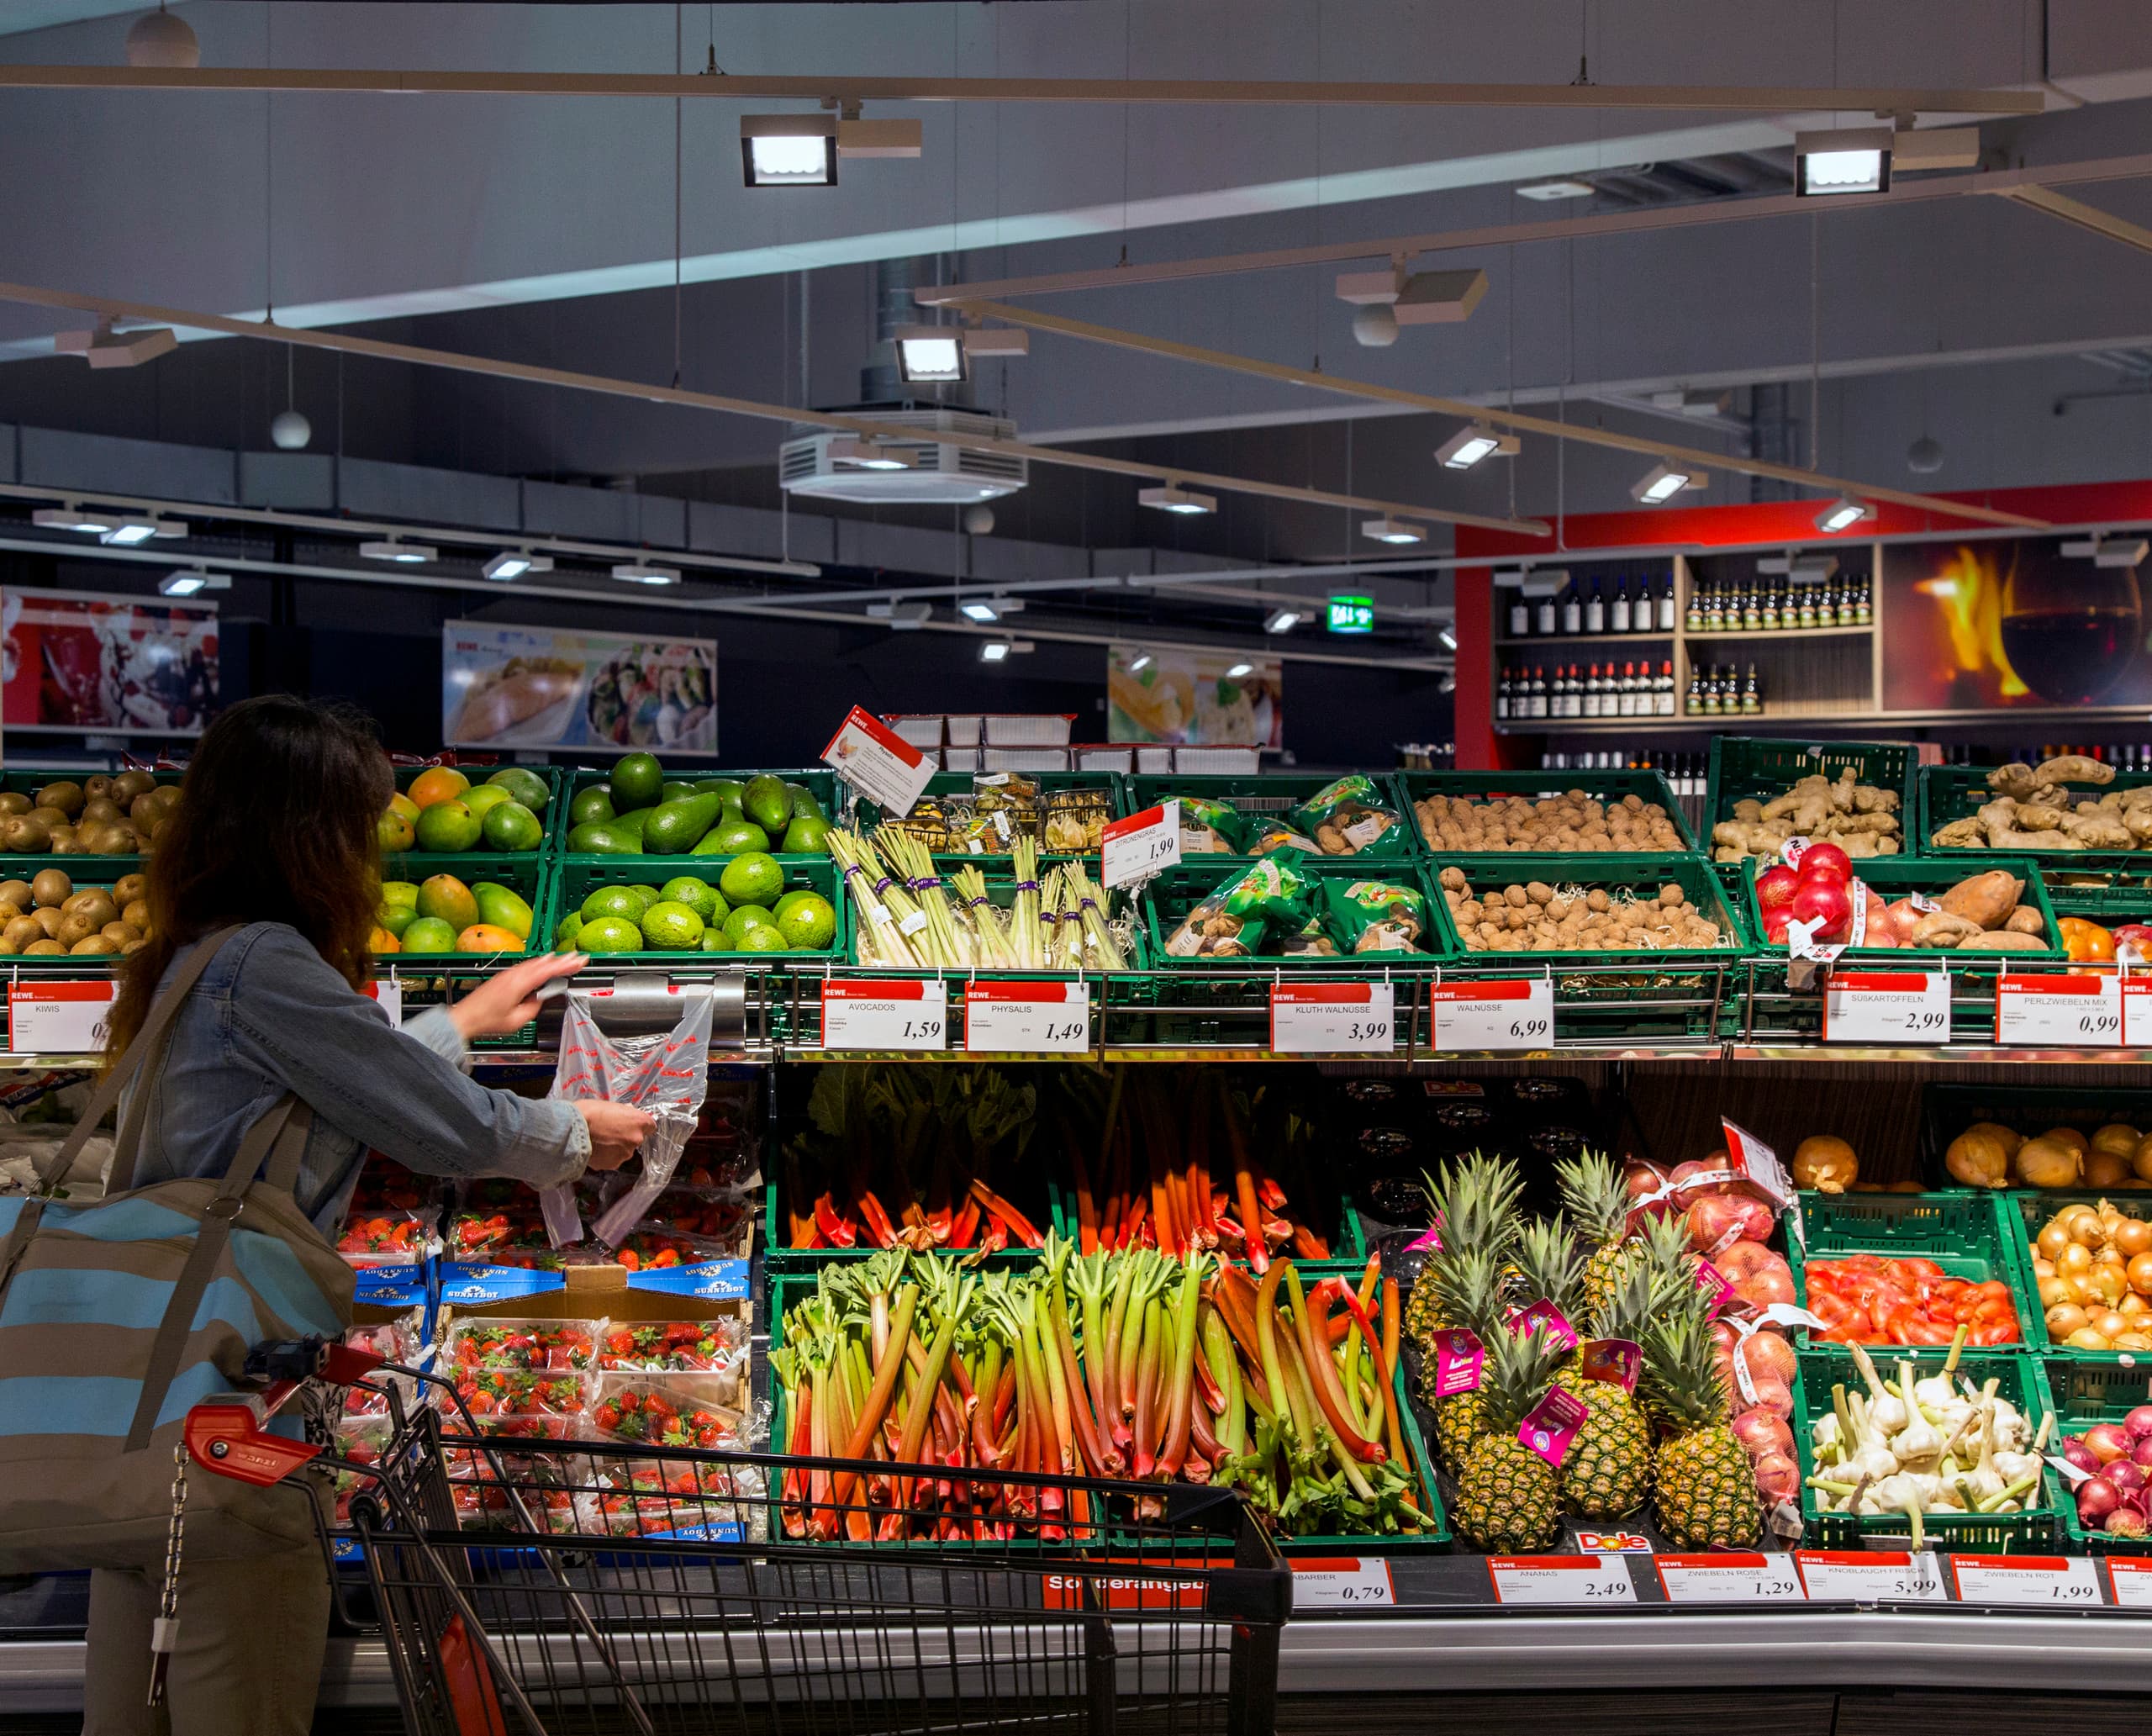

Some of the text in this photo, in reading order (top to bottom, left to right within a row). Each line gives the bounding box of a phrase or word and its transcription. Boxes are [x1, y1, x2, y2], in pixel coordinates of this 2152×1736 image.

[1149, 836, 1174, 860] 1,99
[848, 1003, 896, 1011] AVOCADOS
[1457, 1003, 1503, 1012] WALNÜSSE
[2024, 997, 2108, 1006] PERLZWIEBELN MIX
[35, 1005, 61, 1013] KIWIS
[991, 1005, 1032, 1013] PHYSALIS
[1325, 1005, 1371, 1014] WALNÜSSE
[1905, 1012, 1944, 1032] 2,99
[2080, 1015, 2119, 1035] 0,99
[902, 1021, 941, 1040] 1,59
[1045, 1022, 1084, 1042] 1,49
[1348, 1022, 1387, 1042] 3,99
[1510, 1020, 1548, 1039] 6,99
[447, 1290, 498, 1299] SUNNYBOY
[694, 1285, 746, 1295] SUNNYBOY
[683, 1527, 738, 1536] SUNNBOY
[1579, 1533, 1648, 1549] Dole
[1342, 1586, 1385, 1601] 0,79
[1585, 1582, 1627, 1597] 2,49
[1754, 1581, 1794, 1596] 1,29
[1894, 1580, 1936, 1594] 5,99
[2051, 1586, 2094, 1599] 1,99
